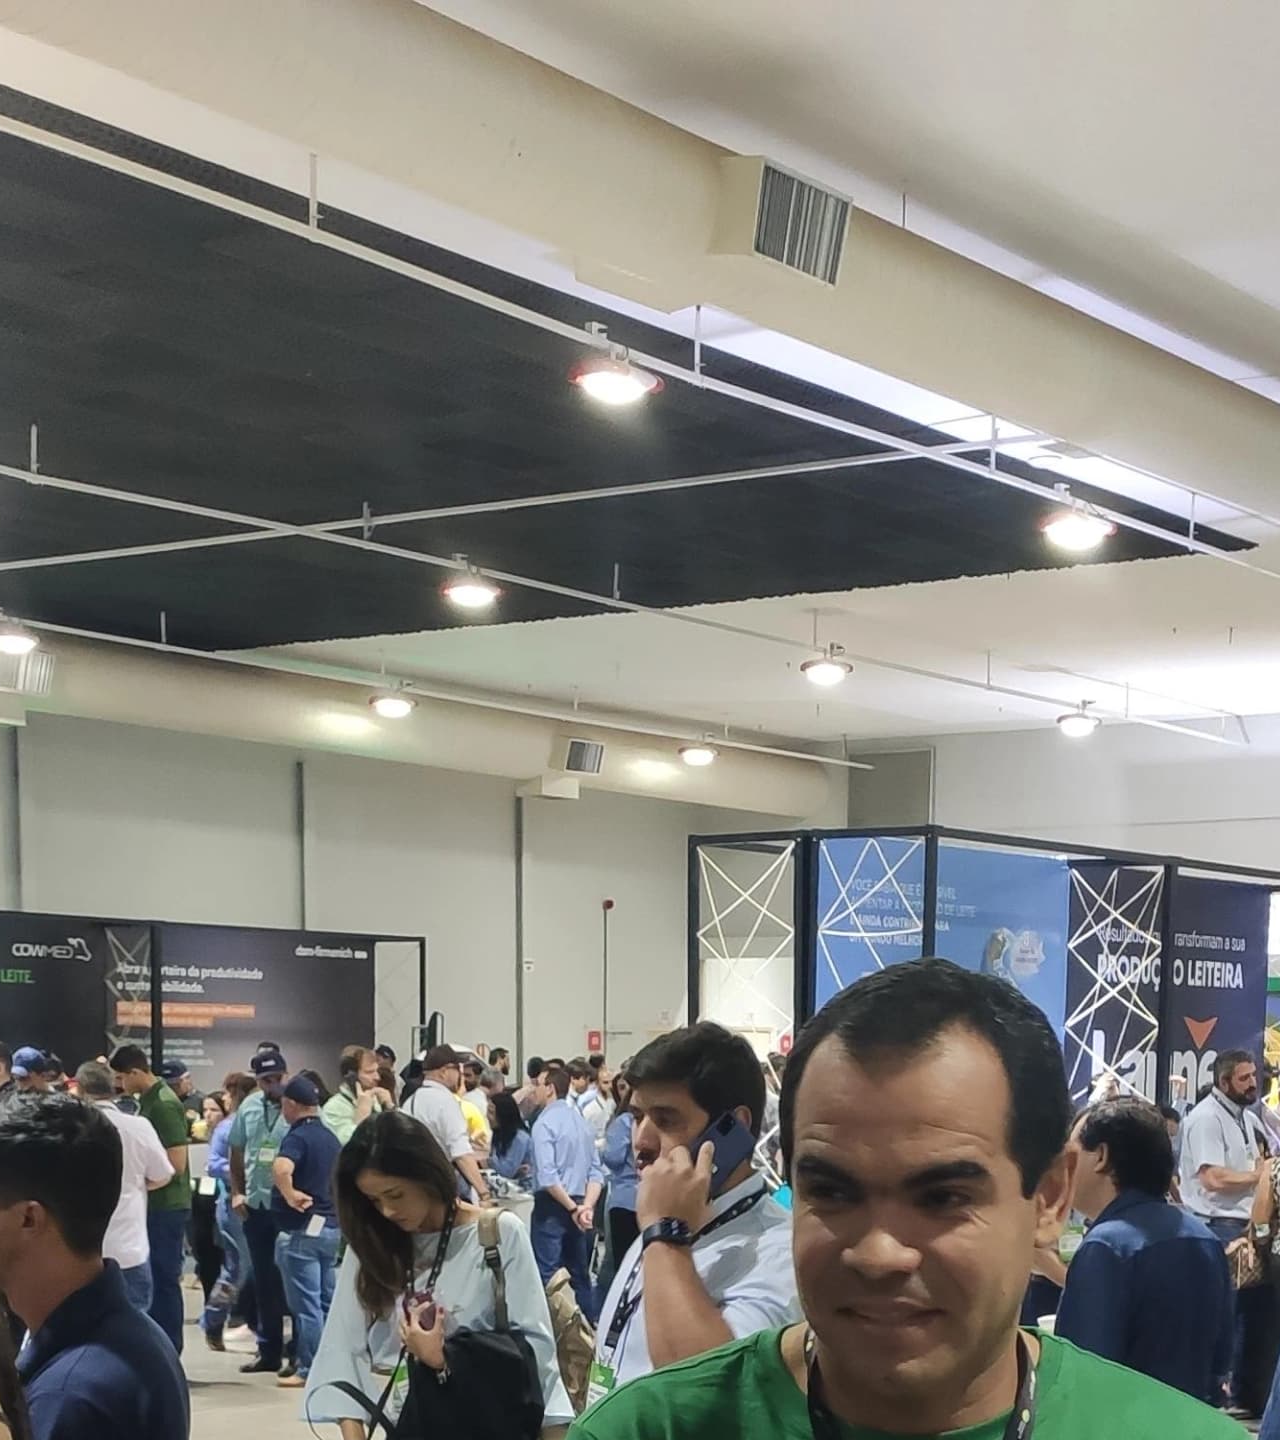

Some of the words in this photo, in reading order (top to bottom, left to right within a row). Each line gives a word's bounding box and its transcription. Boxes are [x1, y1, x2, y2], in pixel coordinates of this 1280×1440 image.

[1175, 931, 1223, 951] ransformam
[1097, 954, 1184, 992] PRODUÇO
[1187, 959, 1244, 989] LEITEIRA
